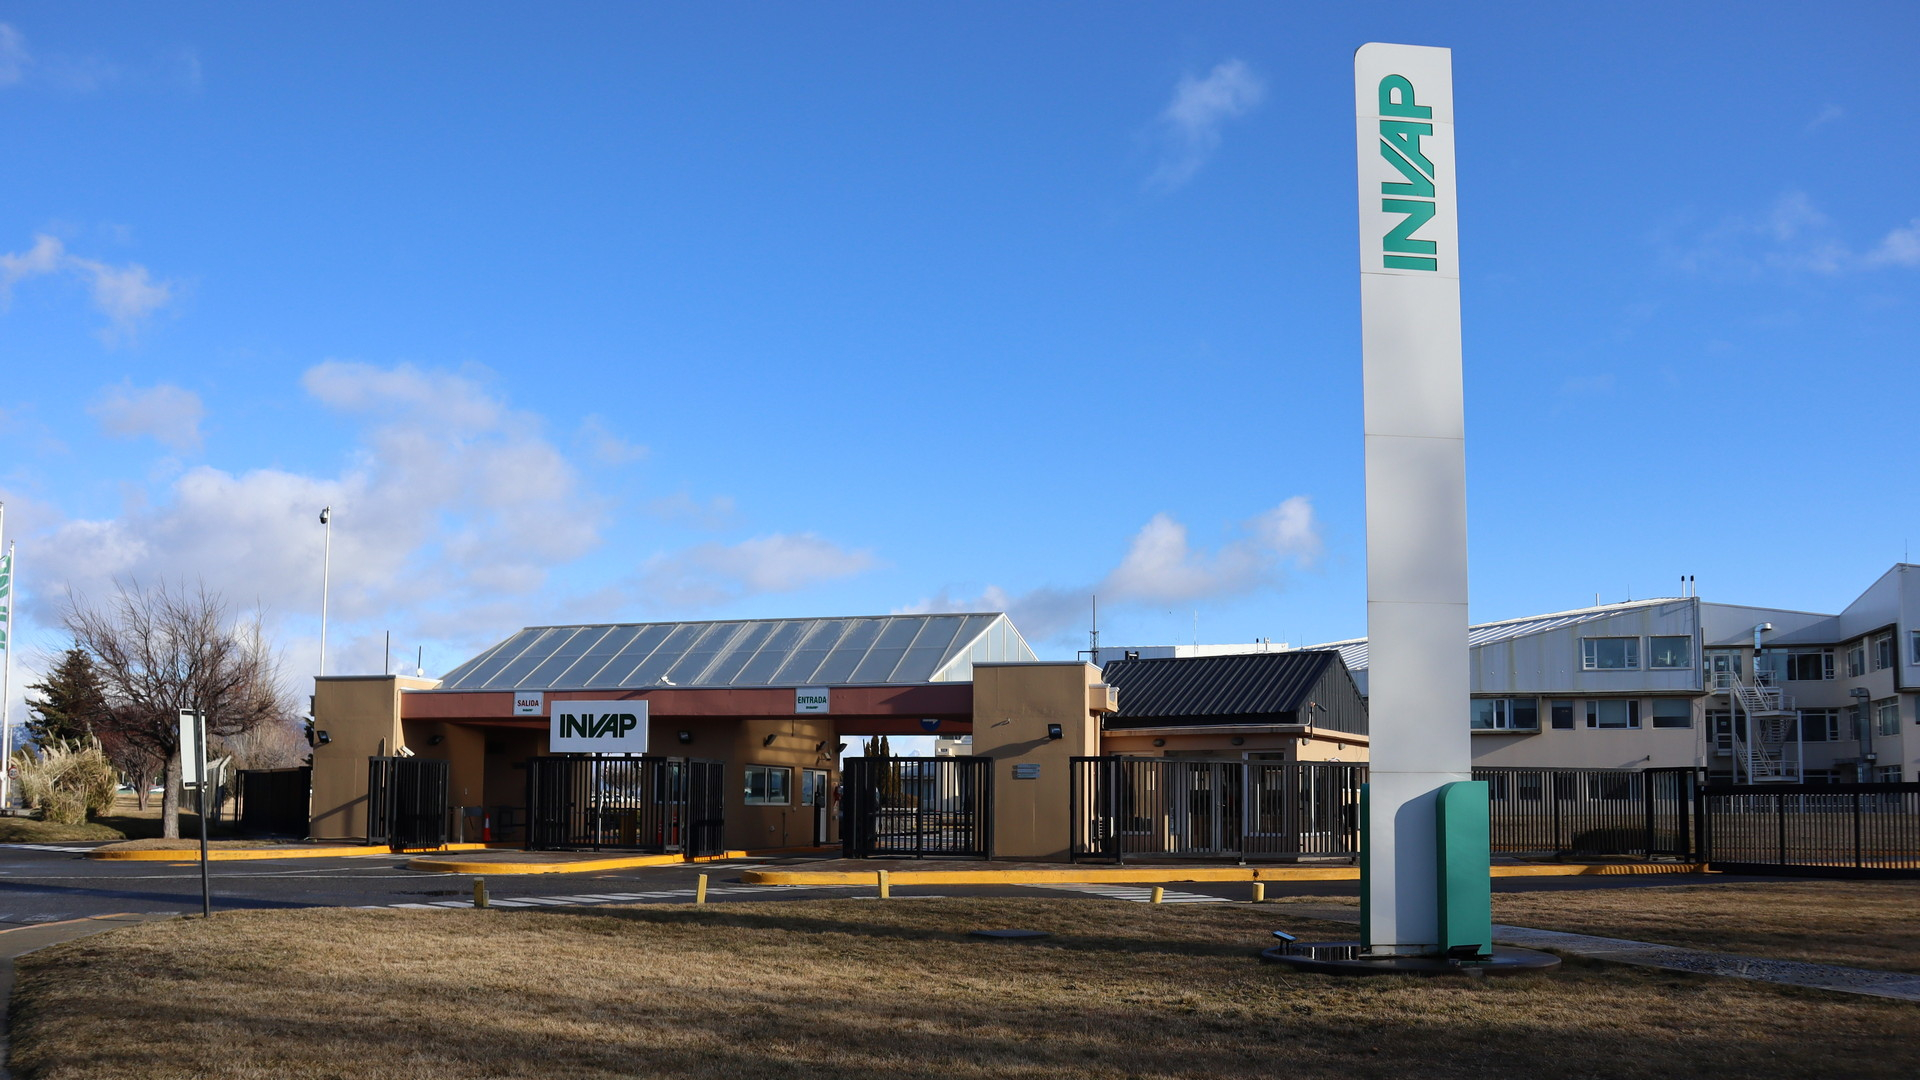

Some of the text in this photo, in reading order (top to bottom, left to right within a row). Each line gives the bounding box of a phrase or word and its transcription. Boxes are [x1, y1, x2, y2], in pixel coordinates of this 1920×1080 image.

[1378, 73, 1437, 271] INVAP
[797, 696, 827, 704] ENTRADA
[559, 713, 637, 738] INVAP
